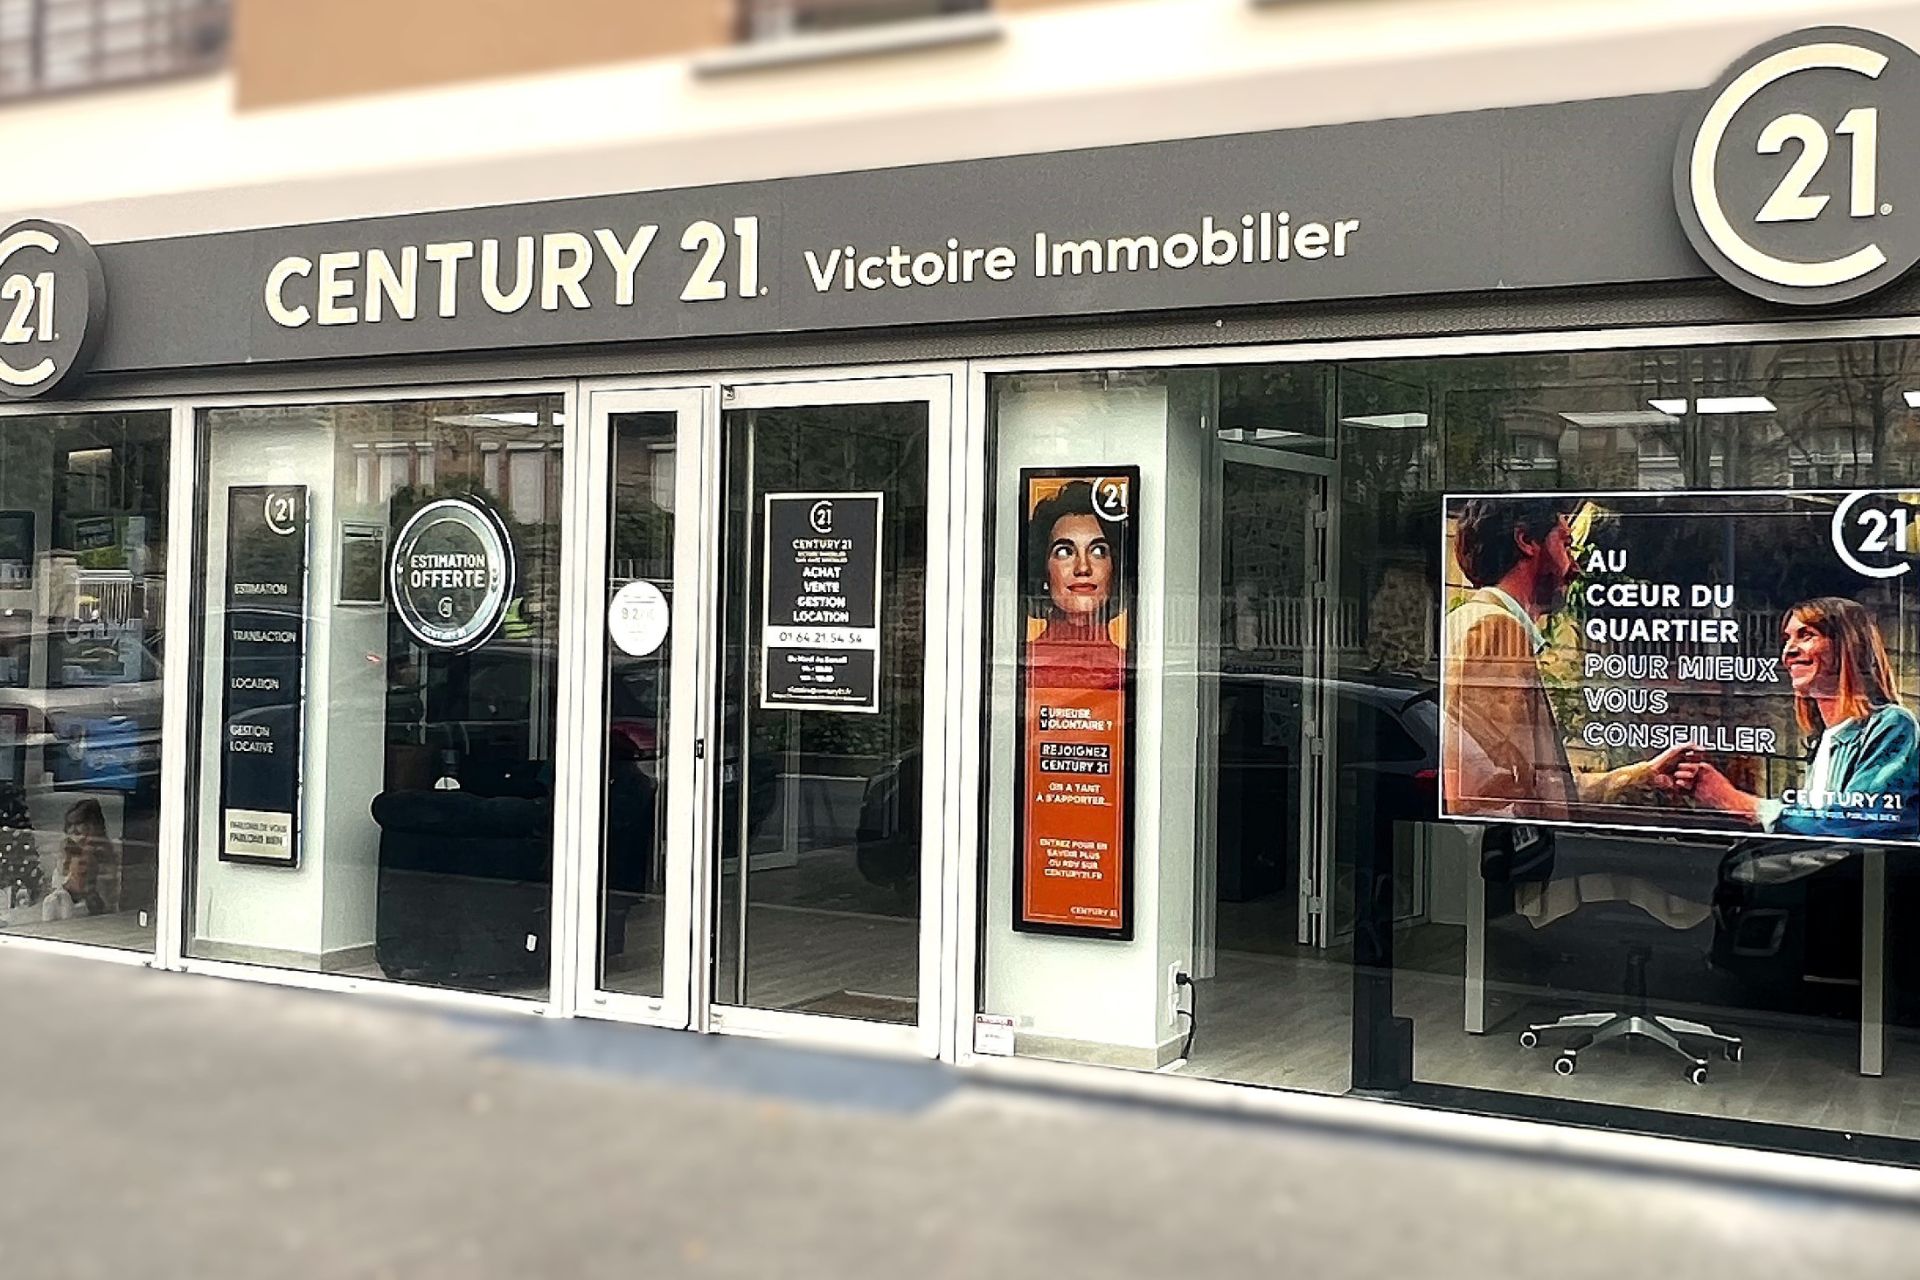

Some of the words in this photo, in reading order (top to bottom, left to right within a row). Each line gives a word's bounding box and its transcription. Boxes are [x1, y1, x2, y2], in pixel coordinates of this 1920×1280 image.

[264, 224, 660, 328] CENTURY
[803, 238, 1017, 293] Victoire
[1033, 210, 1361, 278] Immobilier
[1856, 508, 1907, 552] 21
[792, 539, 841, 550] CENTURY
[842, 540, 853, 550] 21
[410, 553, 486, 568] ESTIMATION
[1585, 549, 1628, 573] AU
[410, 569, 486, 588] OFFERTE
[802, 566, 842, 579] ACHAT
[234, 583, 288, 595] ESTIMATION
[803, 581, 841, 593] VENTE
[797, 596, 847, 609] GESTION
[1585, 584, 1681, 608] CŒUR
[1690, 585, 1735, 608] DU
[792, 610, 850, 623] LOCATION
[232, 630, 297, 643] TRANSACTION
[1584, 619, 1740, 644] QUARTIER
[1584, 653, 1669, 680] POUR
[1677, 657, 1780, 683] MIEUX
[231, 677, 280, 690] LOCATION
[1583, 687, 1669, 714] VOUS
[229, 724, 270, 737] GESTION
[1582, 721, 1777, 754] CONSEILLER
[229, 740, 275, 754] LOCATIVE
[1042, 744, 1108, 758] REJOIGNEZ
[1041, 760, 1094, 772] CENTURY
[1096, 761, 1109, 774] 21
[1782, 789, 1879, 809] CETURY
[1882, 793, 1902, 810] 21
[1070, 905, 1109, 918] CENTURY
